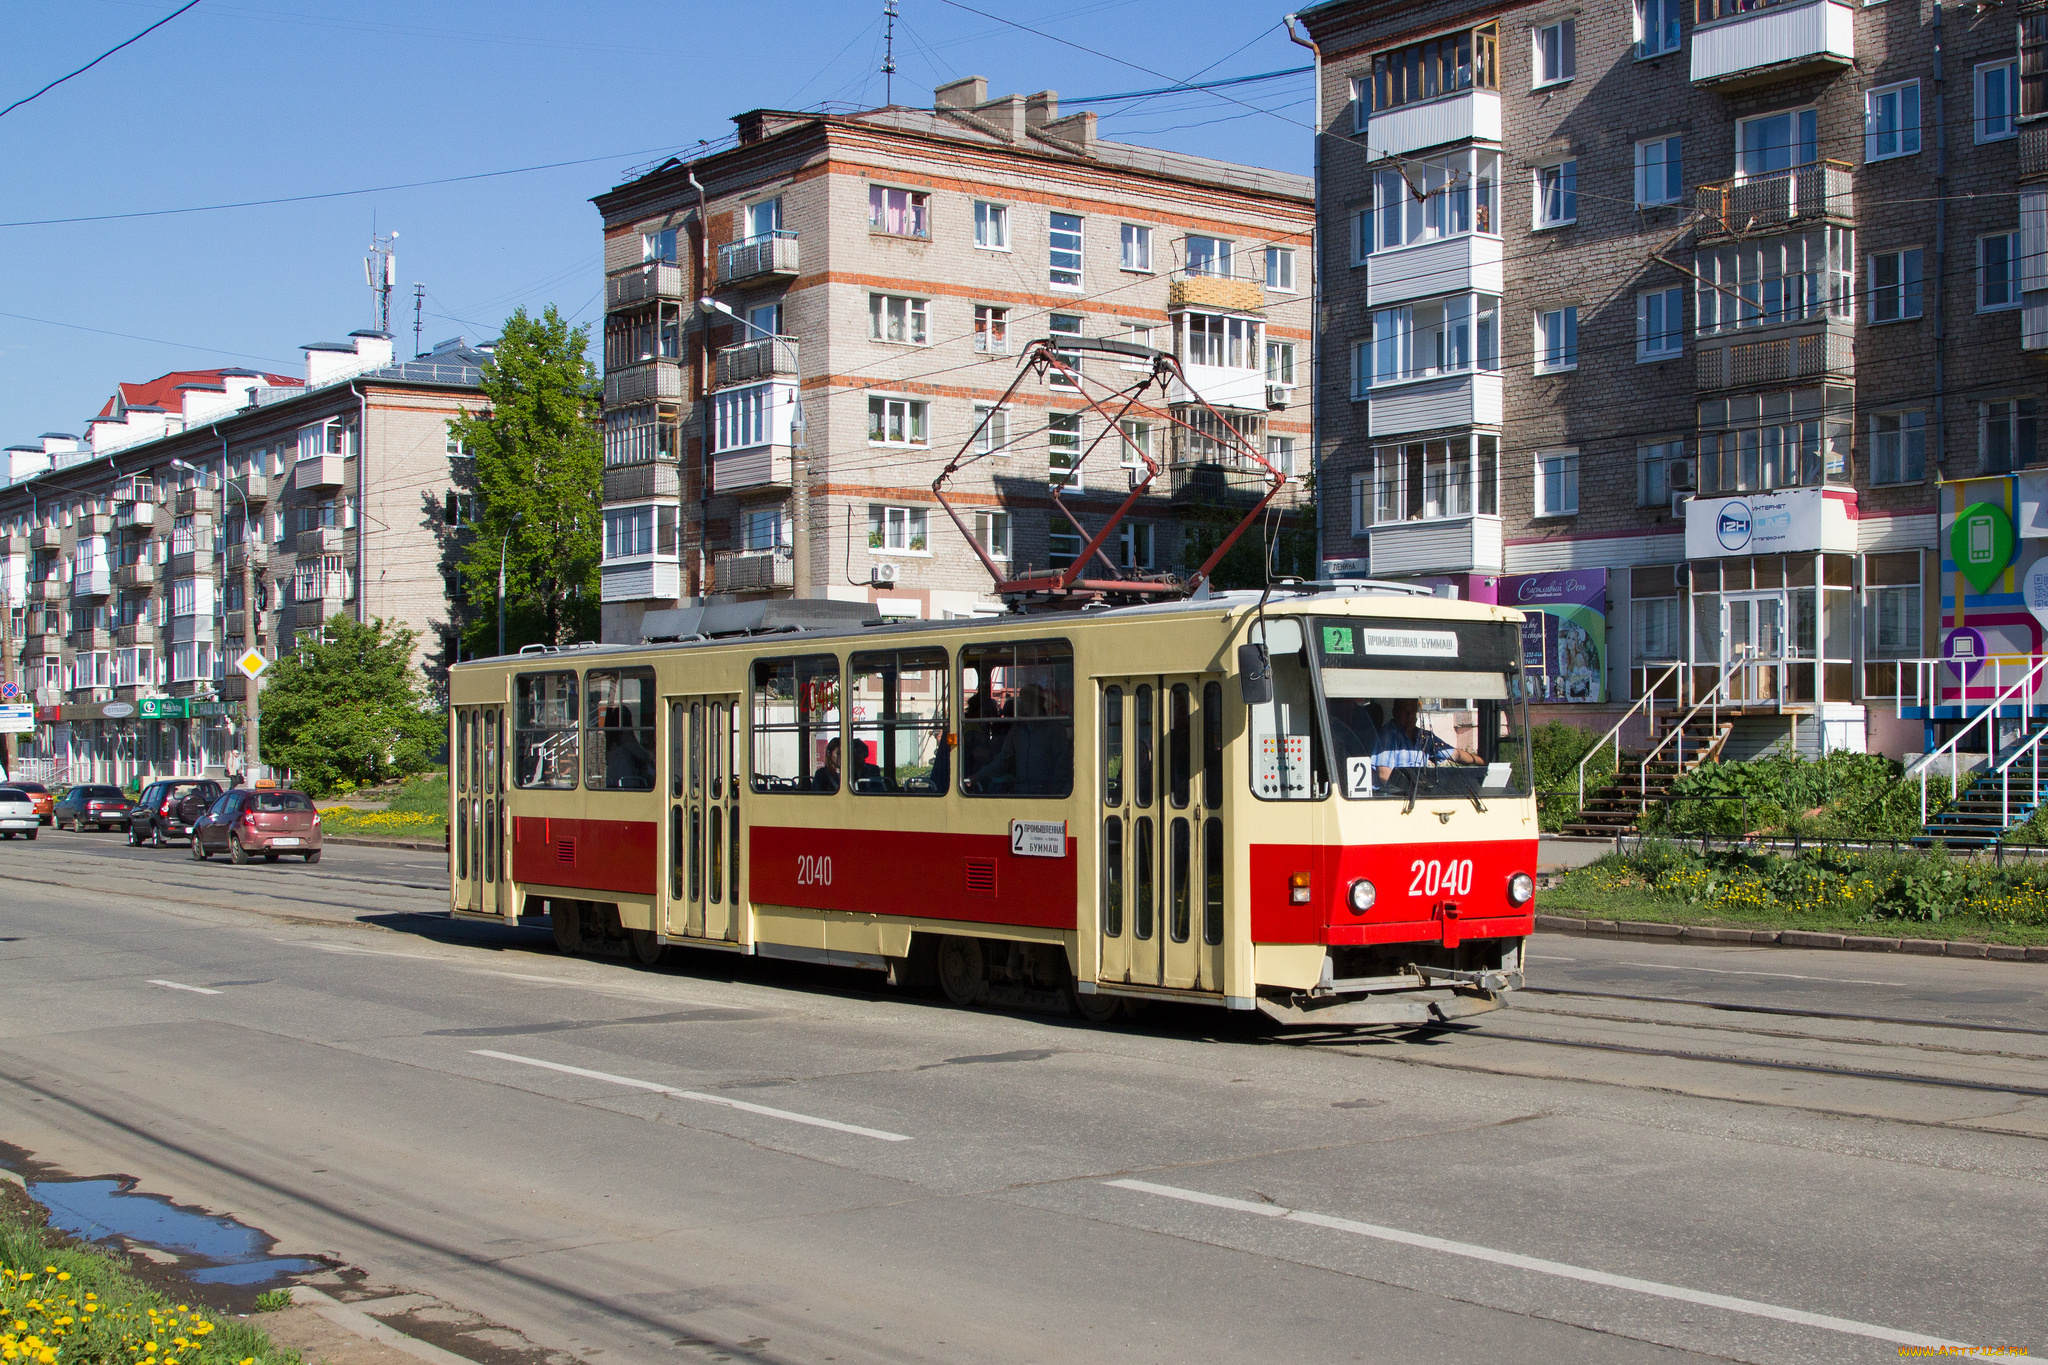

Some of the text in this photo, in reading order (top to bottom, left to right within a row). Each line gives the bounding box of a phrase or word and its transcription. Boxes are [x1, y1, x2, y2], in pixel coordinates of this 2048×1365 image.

[1333, 562, 1356, 571] ЛЕНИНА
[1332, 630, 1344, 651] 2
[800, 682, 834, 713] 2040
[1352, 762, 1368, 793] 2
[1014, 823, 1024, 851] 2
[1029, 842, 1059, 854] БУММАШ
[797, 855, 832, 886] 2040
[1409, 859, 1473, 896] 2040
